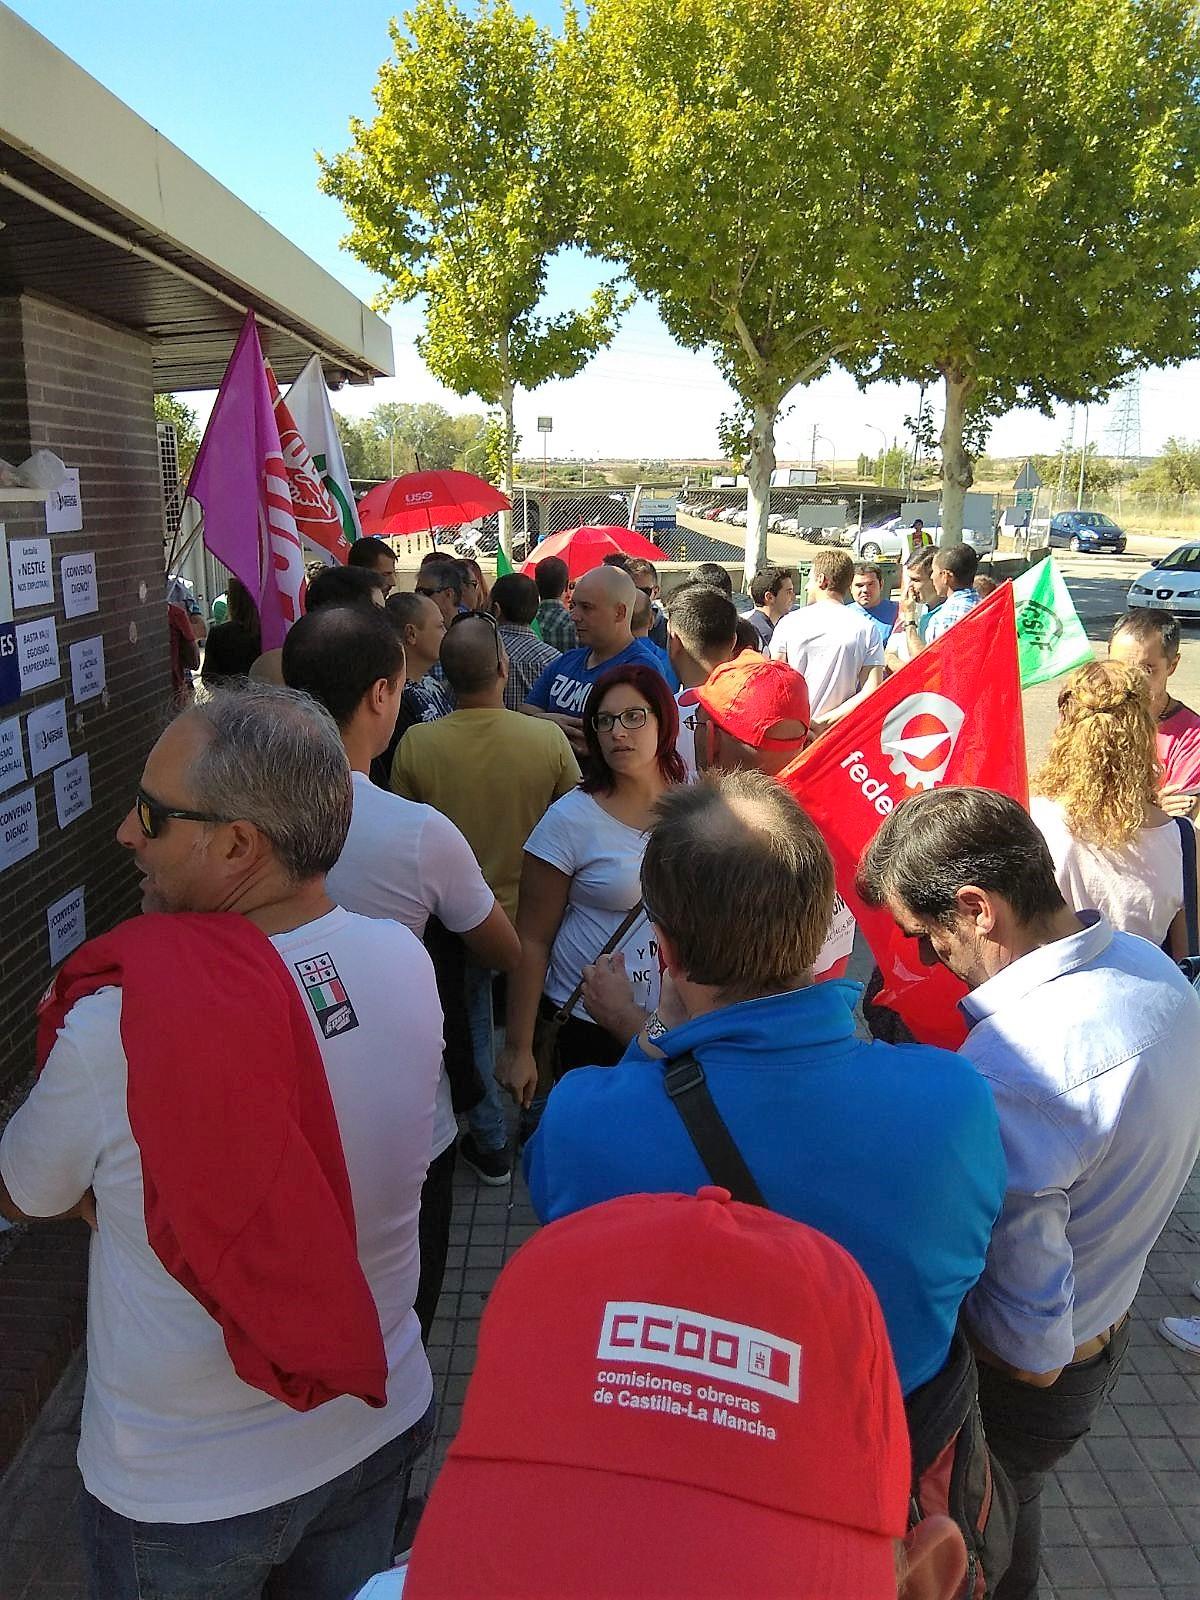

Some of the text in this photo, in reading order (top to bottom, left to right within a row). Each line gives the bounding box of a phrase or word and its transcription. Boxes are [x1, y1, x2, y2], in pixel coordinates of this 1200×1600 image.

[22, 561, 46, 576] NESTLE
[0, 633, 15, 657] ES
[840, 750, 895, 816] fede
[0, 801, 32, 826] CONVENIO
[609, 1314, 740, 1369] CCOO
[593, 1387, 777, 1441] de Castilla-La Mancha
[597, 1370, 760, 1414] comisiones obreras
